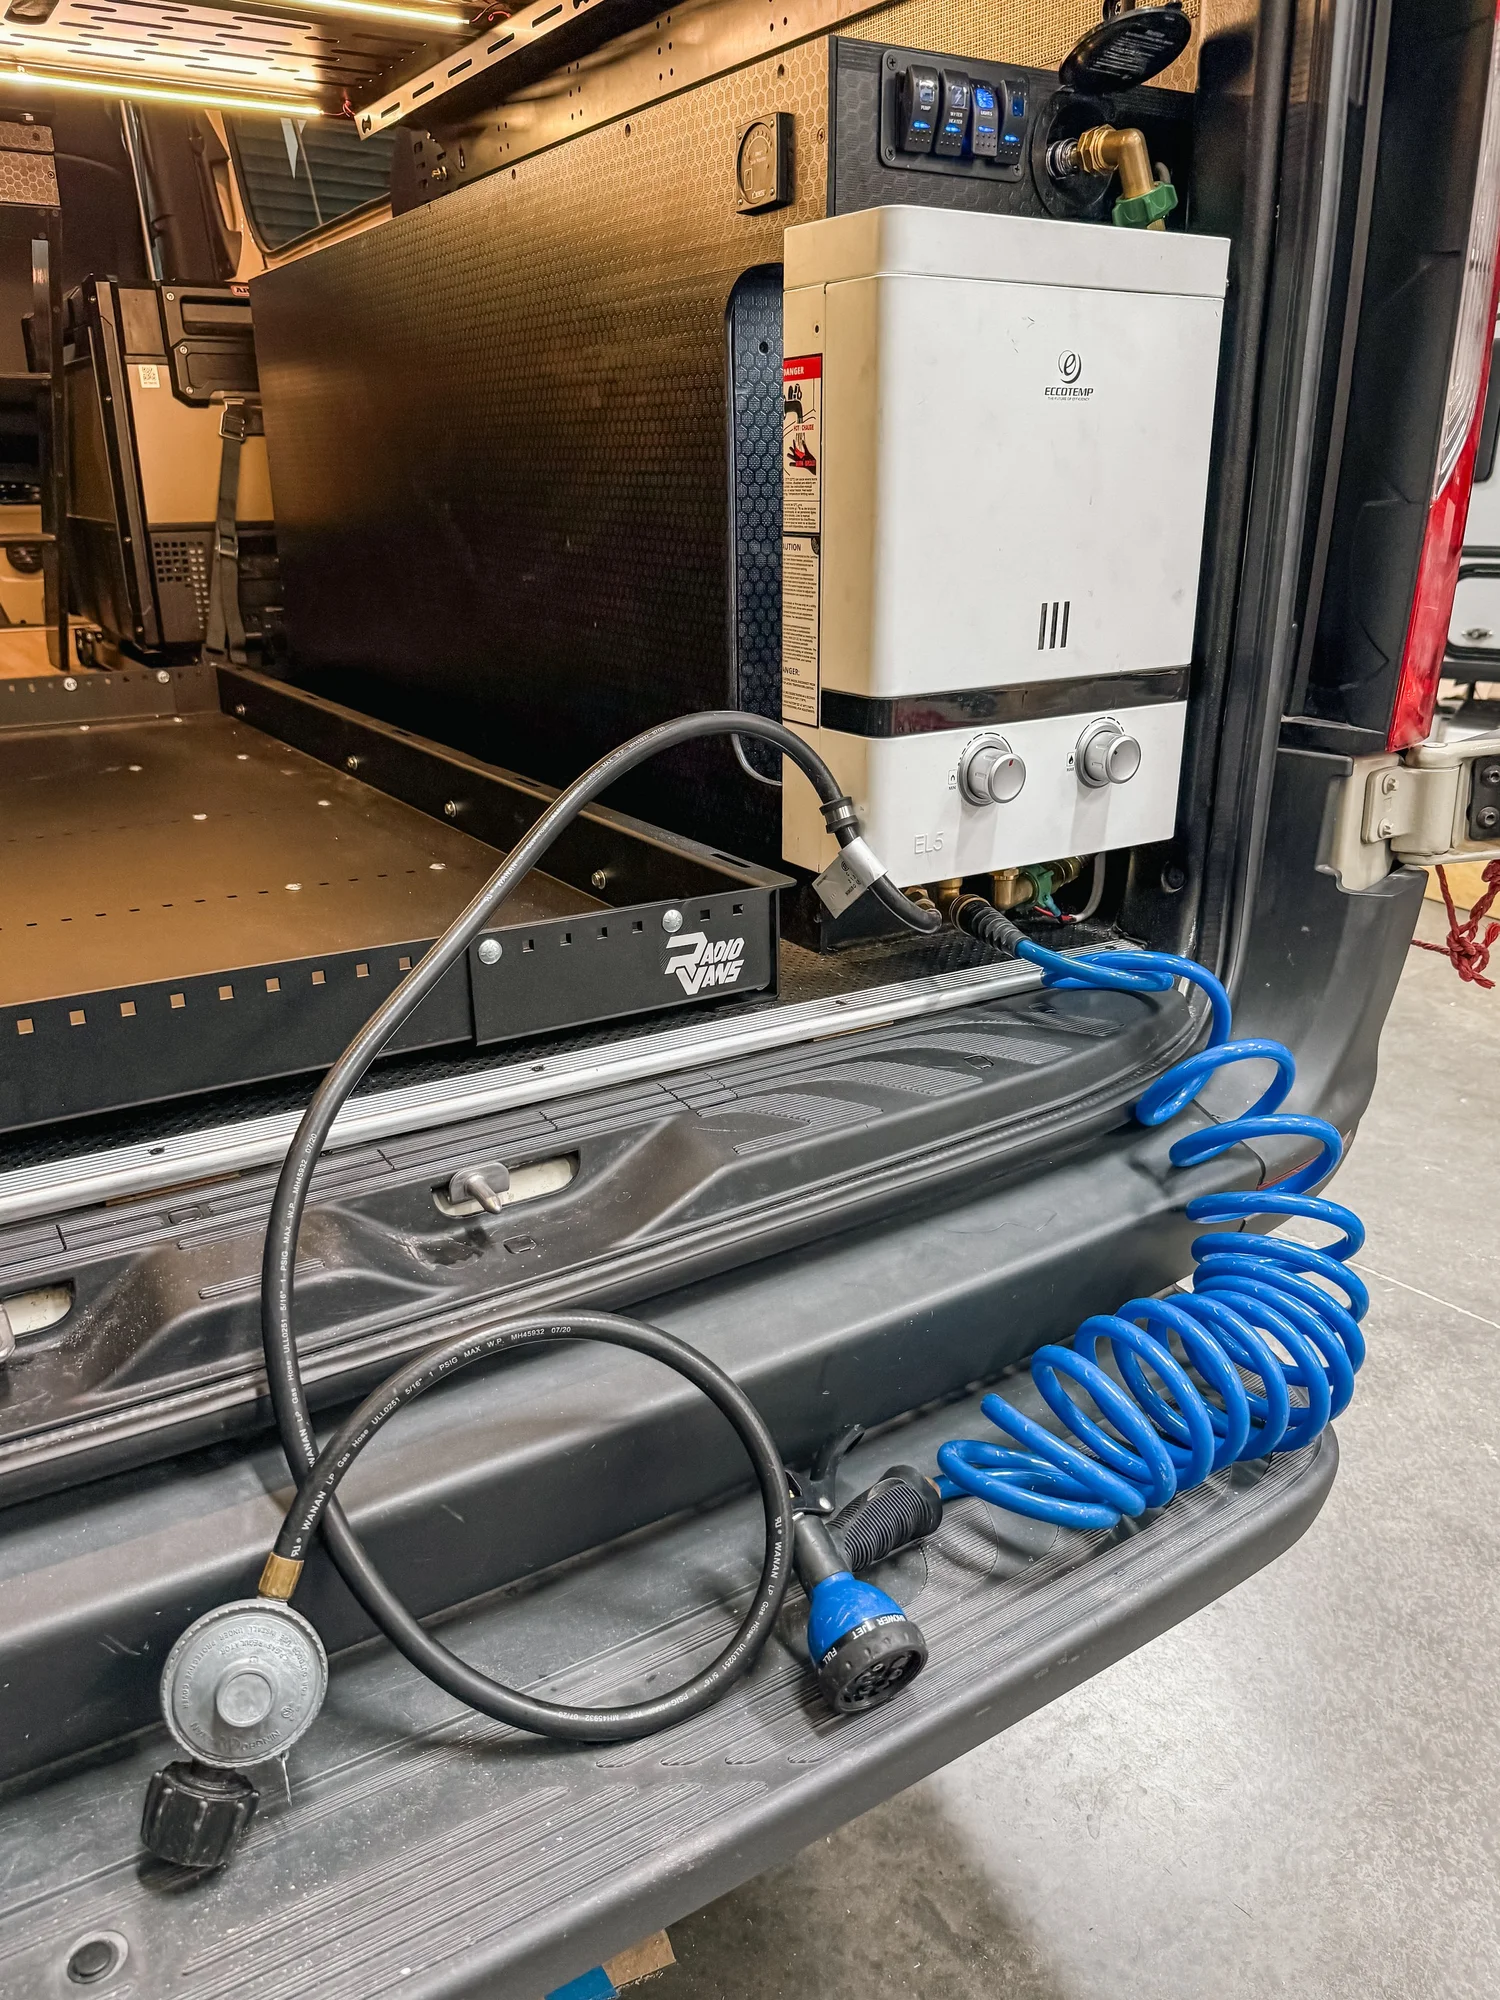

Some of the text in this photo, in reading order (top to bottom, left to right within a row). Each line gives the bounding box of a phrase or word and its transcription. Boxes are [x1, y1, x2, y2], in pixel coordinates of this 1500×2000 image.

[1044, 386, 1094, 397] ECCOTEMP
[914, 831, 944, 854] EL5
[664, 931, 745, 980] RADIO
[675, 959, 745, 996] VANS
[305, 1133, 317, 1154] 07/20
[292, 1159, 308, 1194] MH45932
[283, 1225, 292, 1243] MAX
[280, 1251, 289, 1271] PSIG
[286, 1361, 294, 1381] Hose
[295, 1411, 304, 1422] LP
[302, 1491, 326, 1530] WANAN
[326, 1473, 335, 1485] LP
[337, 1452, 351, 1468] Gas
[352, 1429, 369, 1447] Hose
[371, 1397, 400, 1425] ULL0251
[439, 1356, 458, 1371] PSIG
[463, 1345, 482, 1358] MAX
[511, 1328, 545, 1341] MH45932
[551, 1326, 571, 1334] 07/20
[770, 1541, 782, 1579] WANAN
[768, 1584, 775, 1595] LP
[759, 1601, 769, 1616] Gas
[219, 1627, 244, 1641] UNDER
[747, 1621, 760, 1639] Hose
[851, 1624, 869, 1640] JET
[184, 1640, 216, 1681] PROTECTIVE
[721, 1643, 746, 1670] ULL0251
[822, 1647, 838, 1665] FULL
[670, 1693, 689, 1706] PSIG
